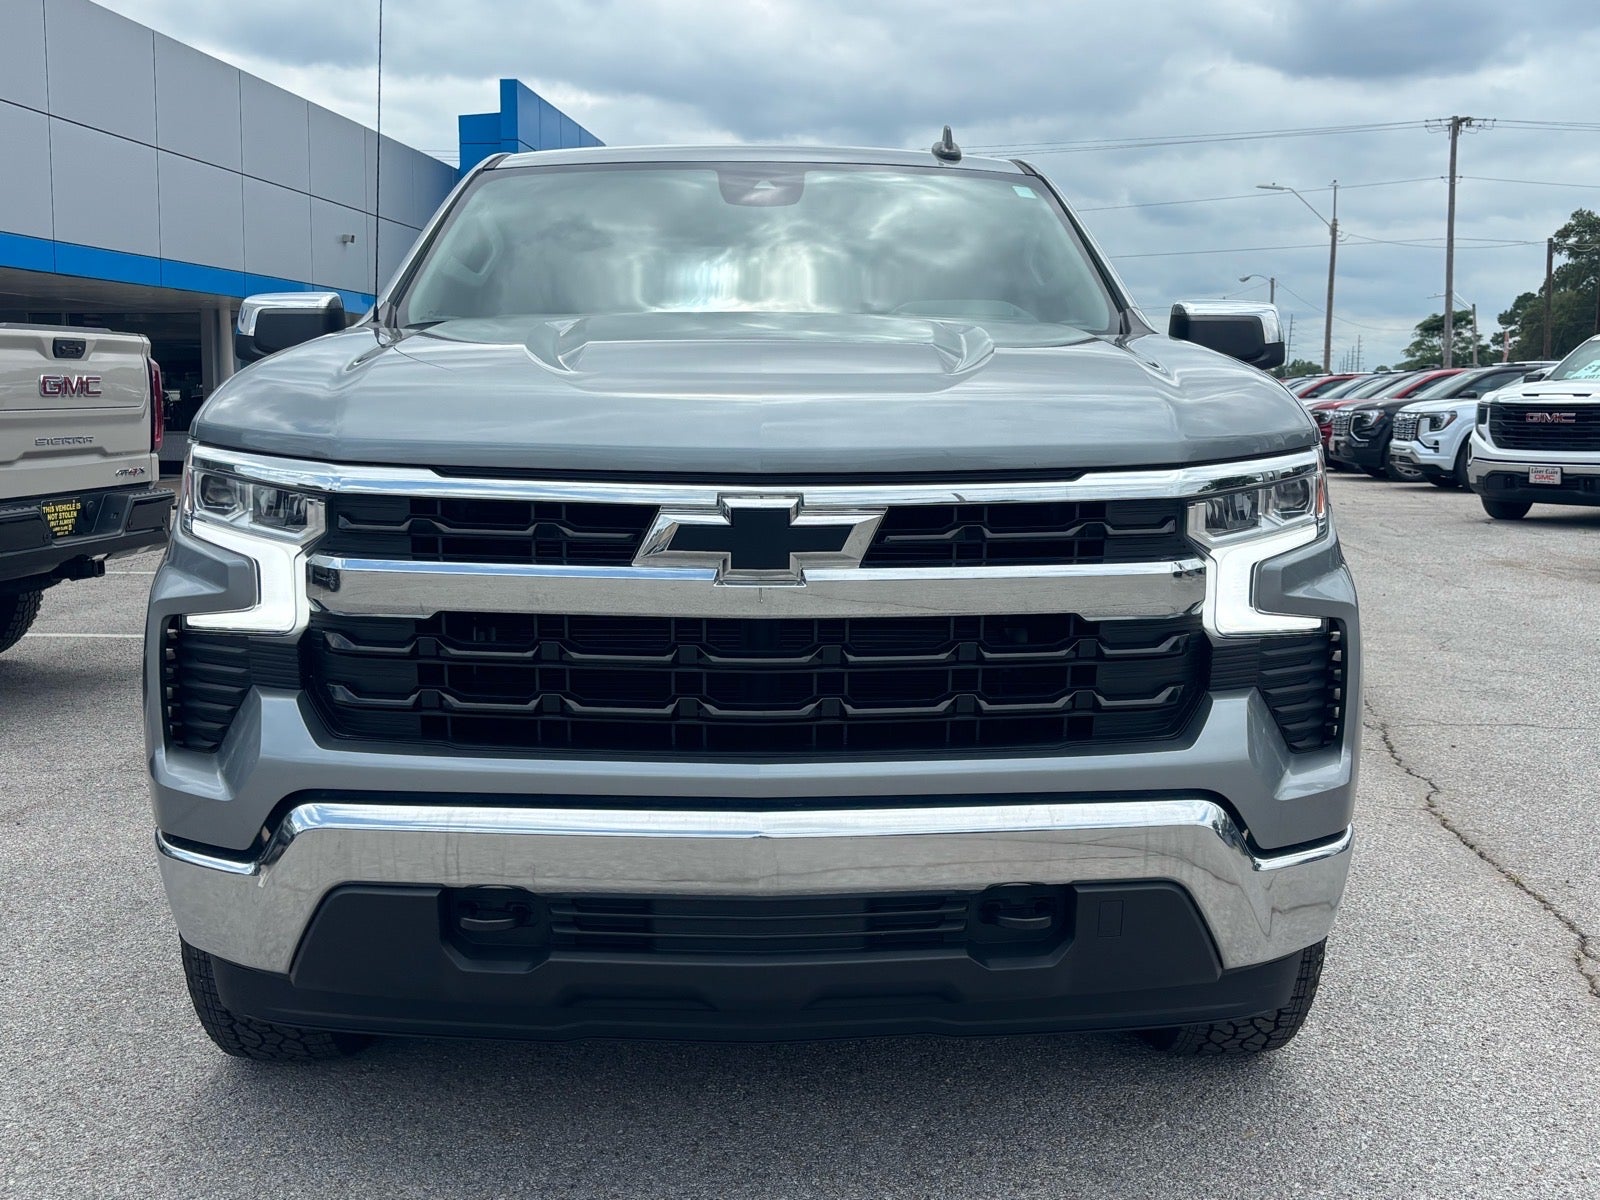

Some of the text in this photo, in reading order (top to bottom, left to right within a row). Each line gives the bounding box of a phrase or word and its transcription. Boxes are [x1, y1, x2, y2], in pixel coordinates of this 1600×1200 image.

[39, 374, 103, 397] GMC
[1525, 412, 1577, 423] GMC
[35, 436, 94, 446] SIERRA
[42, 502, 81, 513] THIS VEHICLE IS
[58, 511, 77, 519] STOLEN
